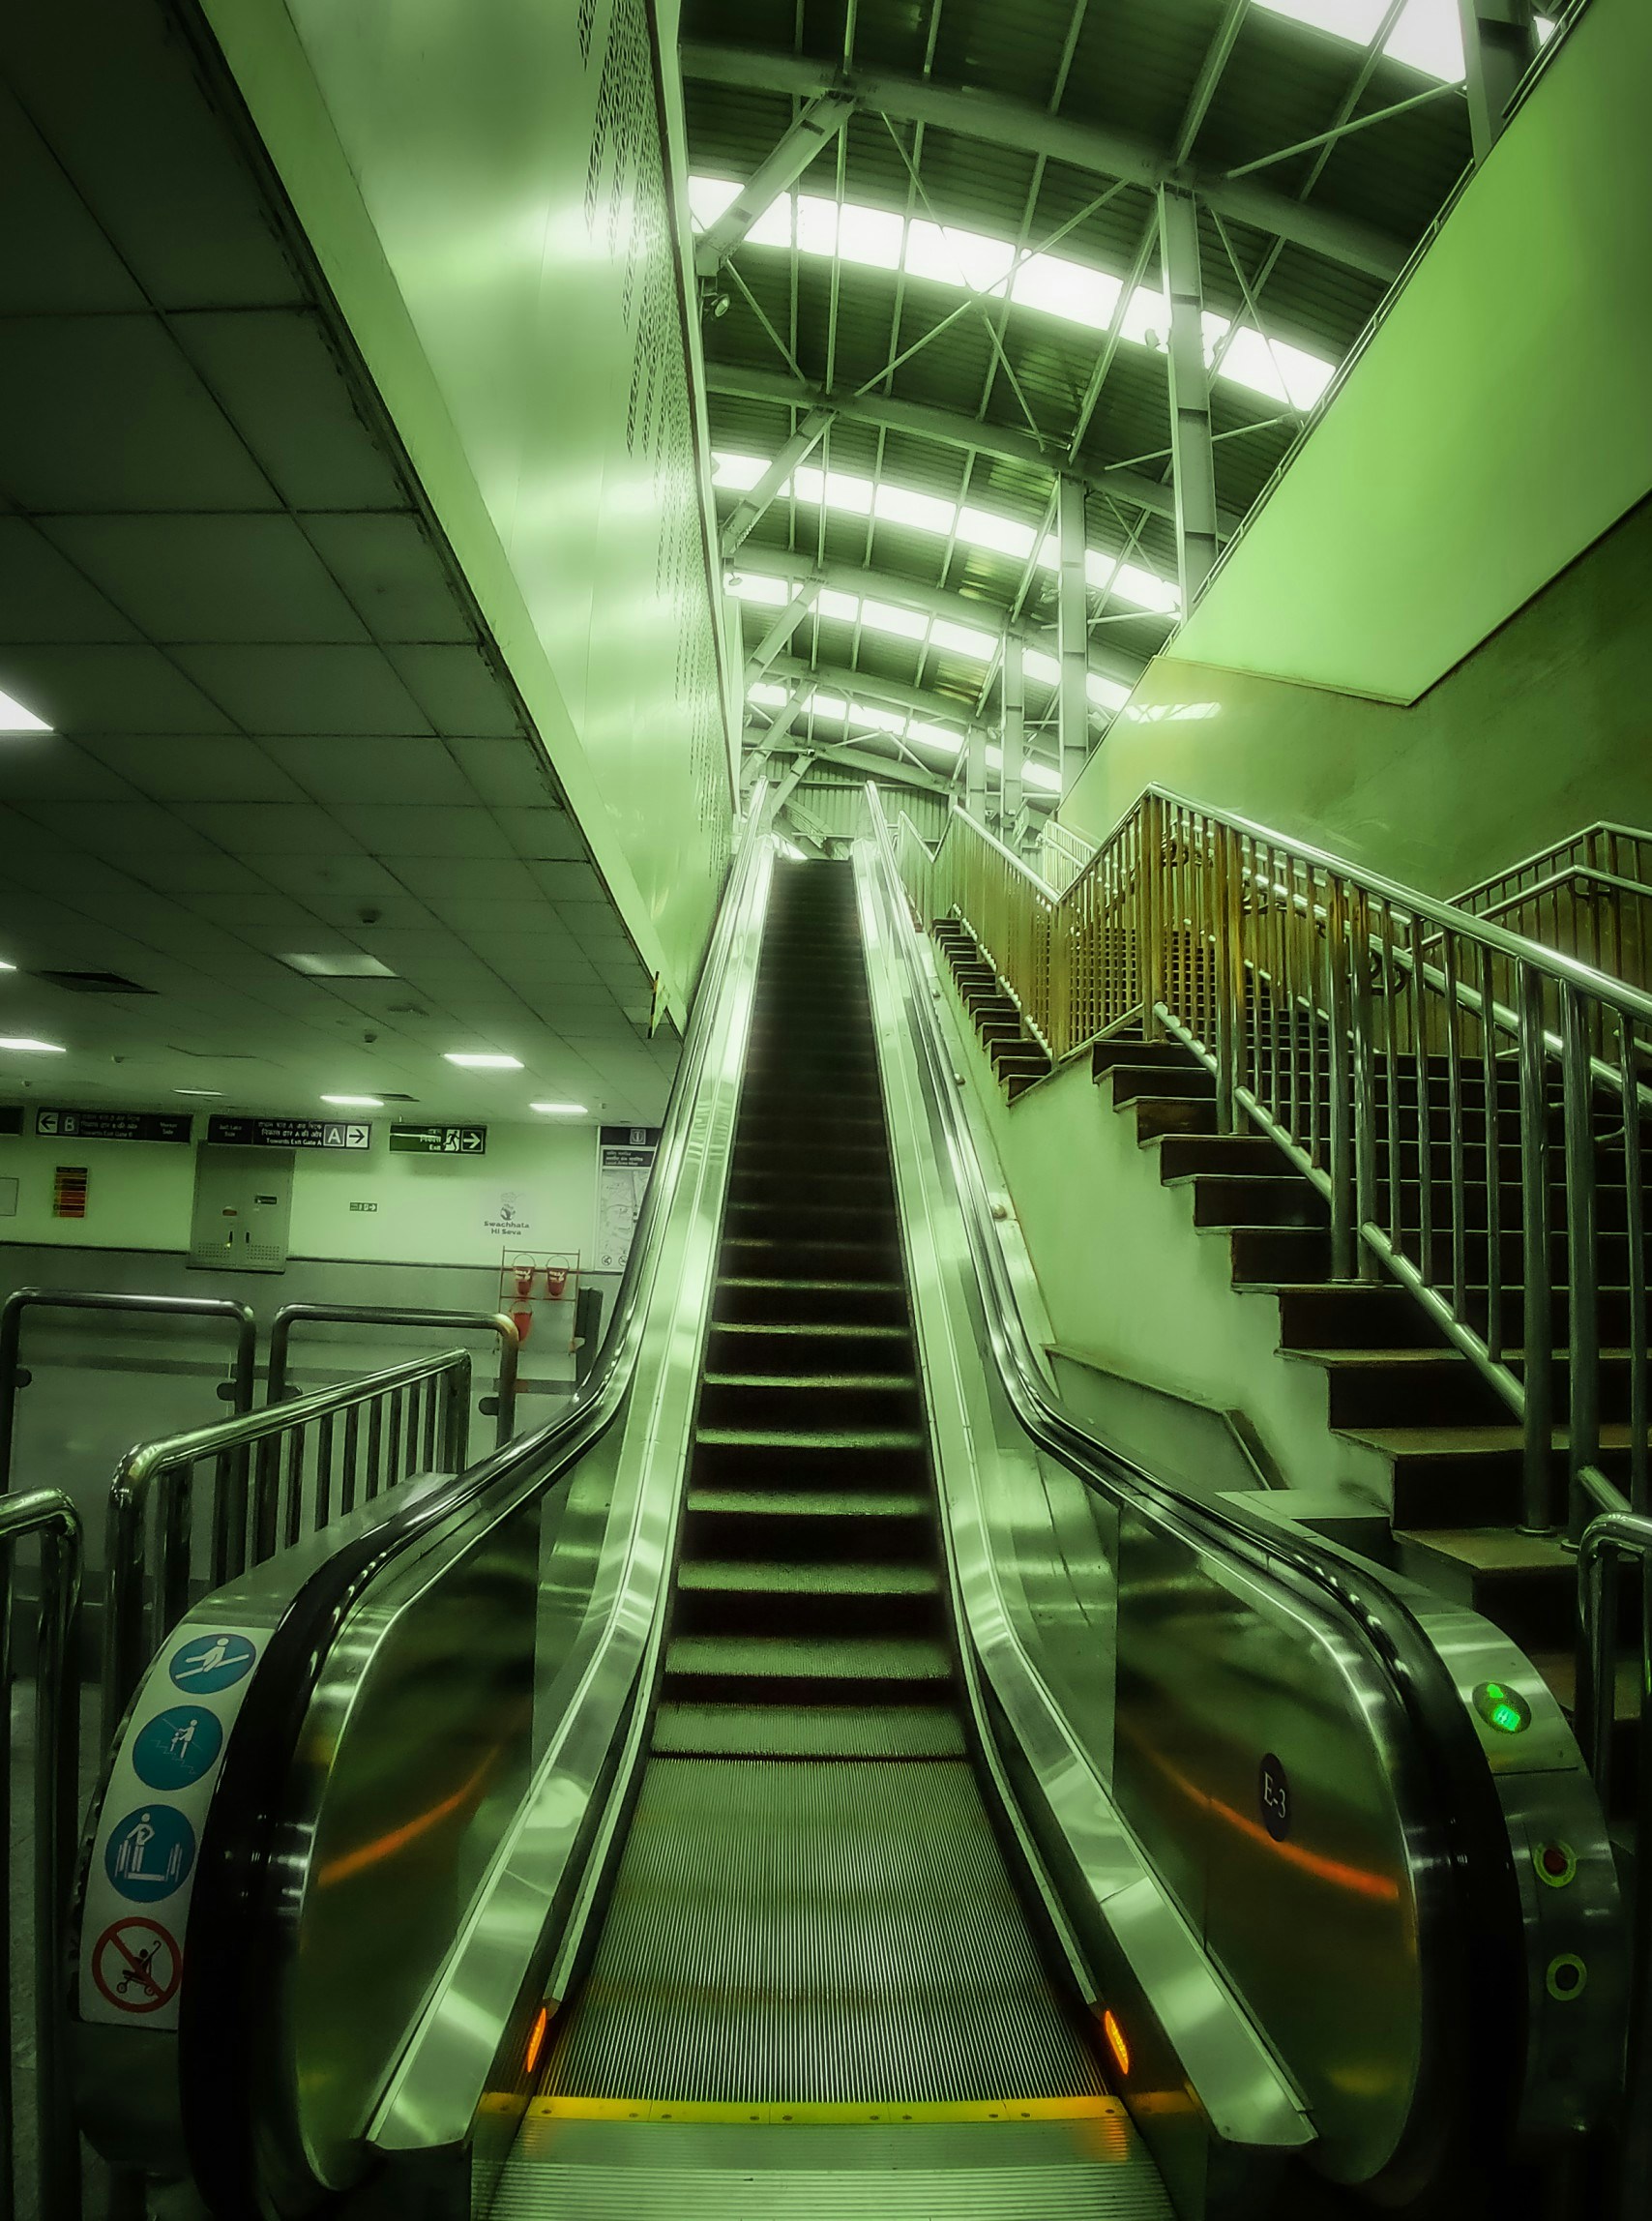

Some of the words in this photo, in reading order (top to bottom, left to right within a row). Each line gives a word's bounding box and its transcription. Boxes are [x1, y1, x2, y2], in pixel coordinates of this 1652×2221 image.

[64, 1115, 75, 1132] B
[327, 1127, 342, 1144] A
[1263, 1770, 1286, 1819] E-3
